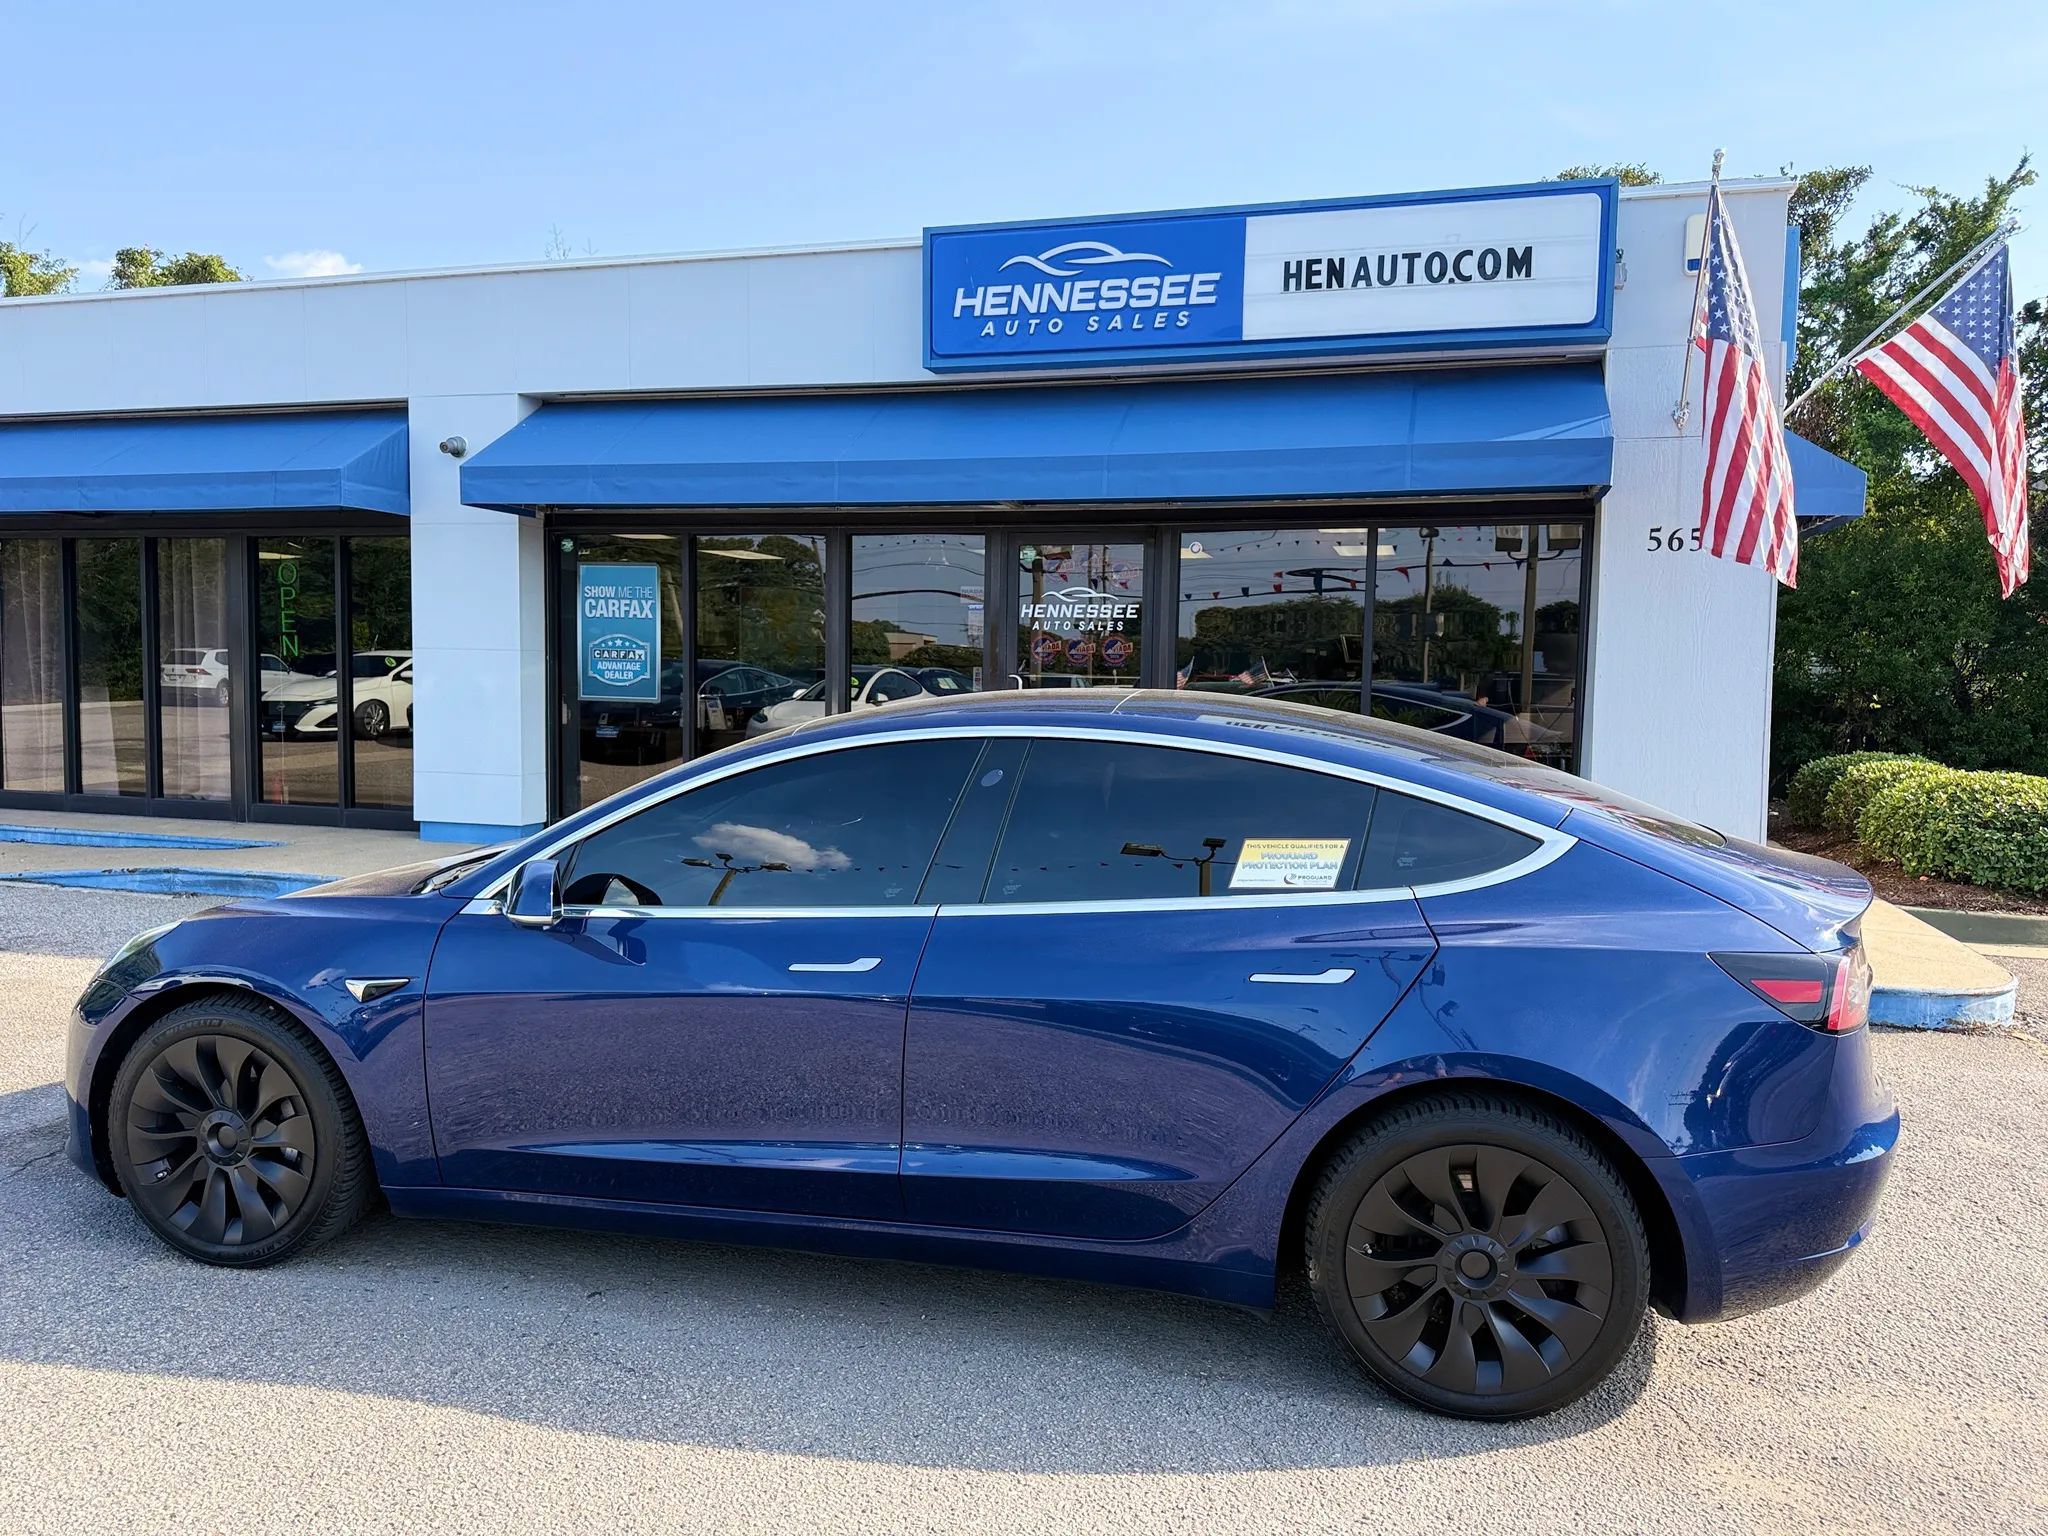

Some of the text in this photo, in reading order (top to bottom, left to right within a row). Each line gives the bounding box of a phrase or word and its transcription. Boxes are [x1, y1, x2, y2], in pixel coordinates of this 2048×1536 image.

[953, 272, 1222, 318] HENNESSEE
[981, 311, 1190, 337] AUTO SALES
[585, 586, 653, 598] SHOW ME THE
[278, 562, 298, 657] OPEN
[585, 599, 654, 618] CARFAX
[1020, 604, 1139, 618] HENNESSEE
[1032, 621, 1124, 631] AUTO SALES
[594, 650, 645, 660] CARFAX
[597, 661, 641, 671] ADVANTAGE
[604, 671, 634, 680] DEALER
[1261, 852, 1318, 860] PROGUARD
[1242, 862, 1338, 870] PROTECTION PLAN
